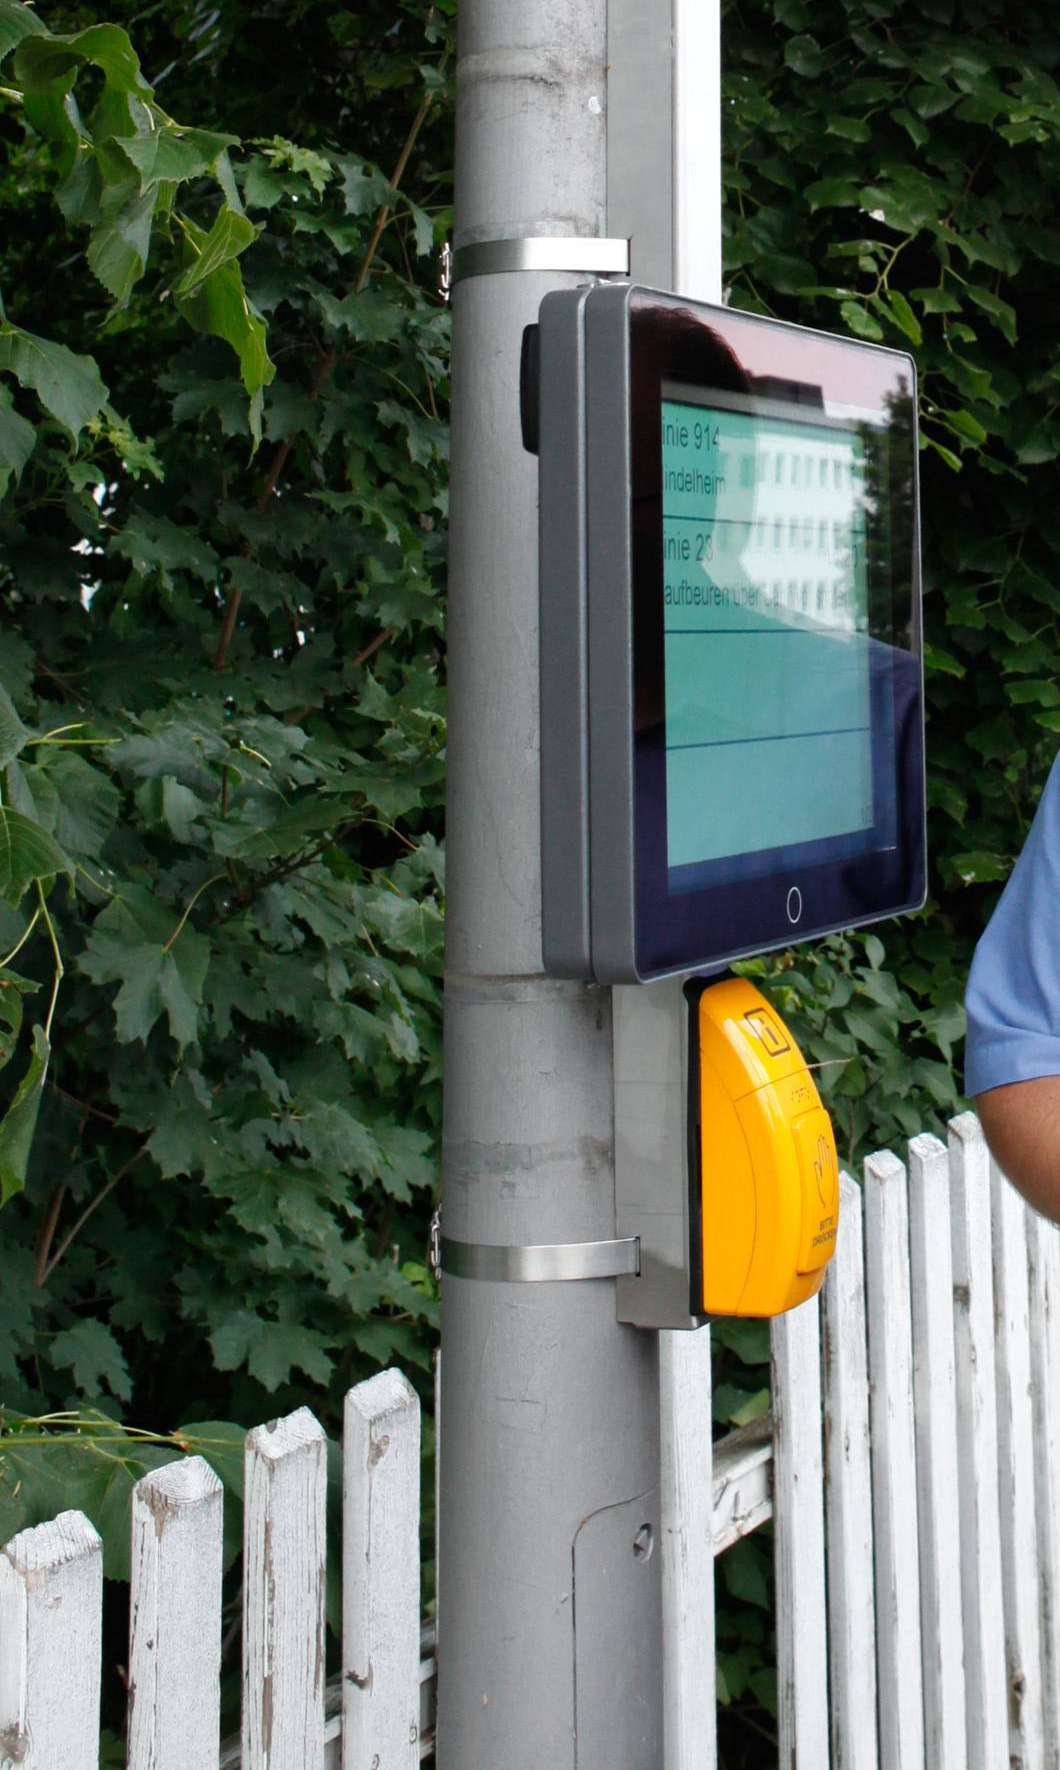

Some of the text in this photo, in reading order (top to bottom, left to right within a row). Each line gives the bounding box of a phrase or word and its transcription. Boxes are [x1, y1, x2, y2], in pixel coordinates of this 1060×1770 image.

[662, 415, 689, 447] inie
[664, 463, 726, 495] indelheim
[664, 532, 690, 561] inie
[664, 579, 730, 607] aufbeuren
